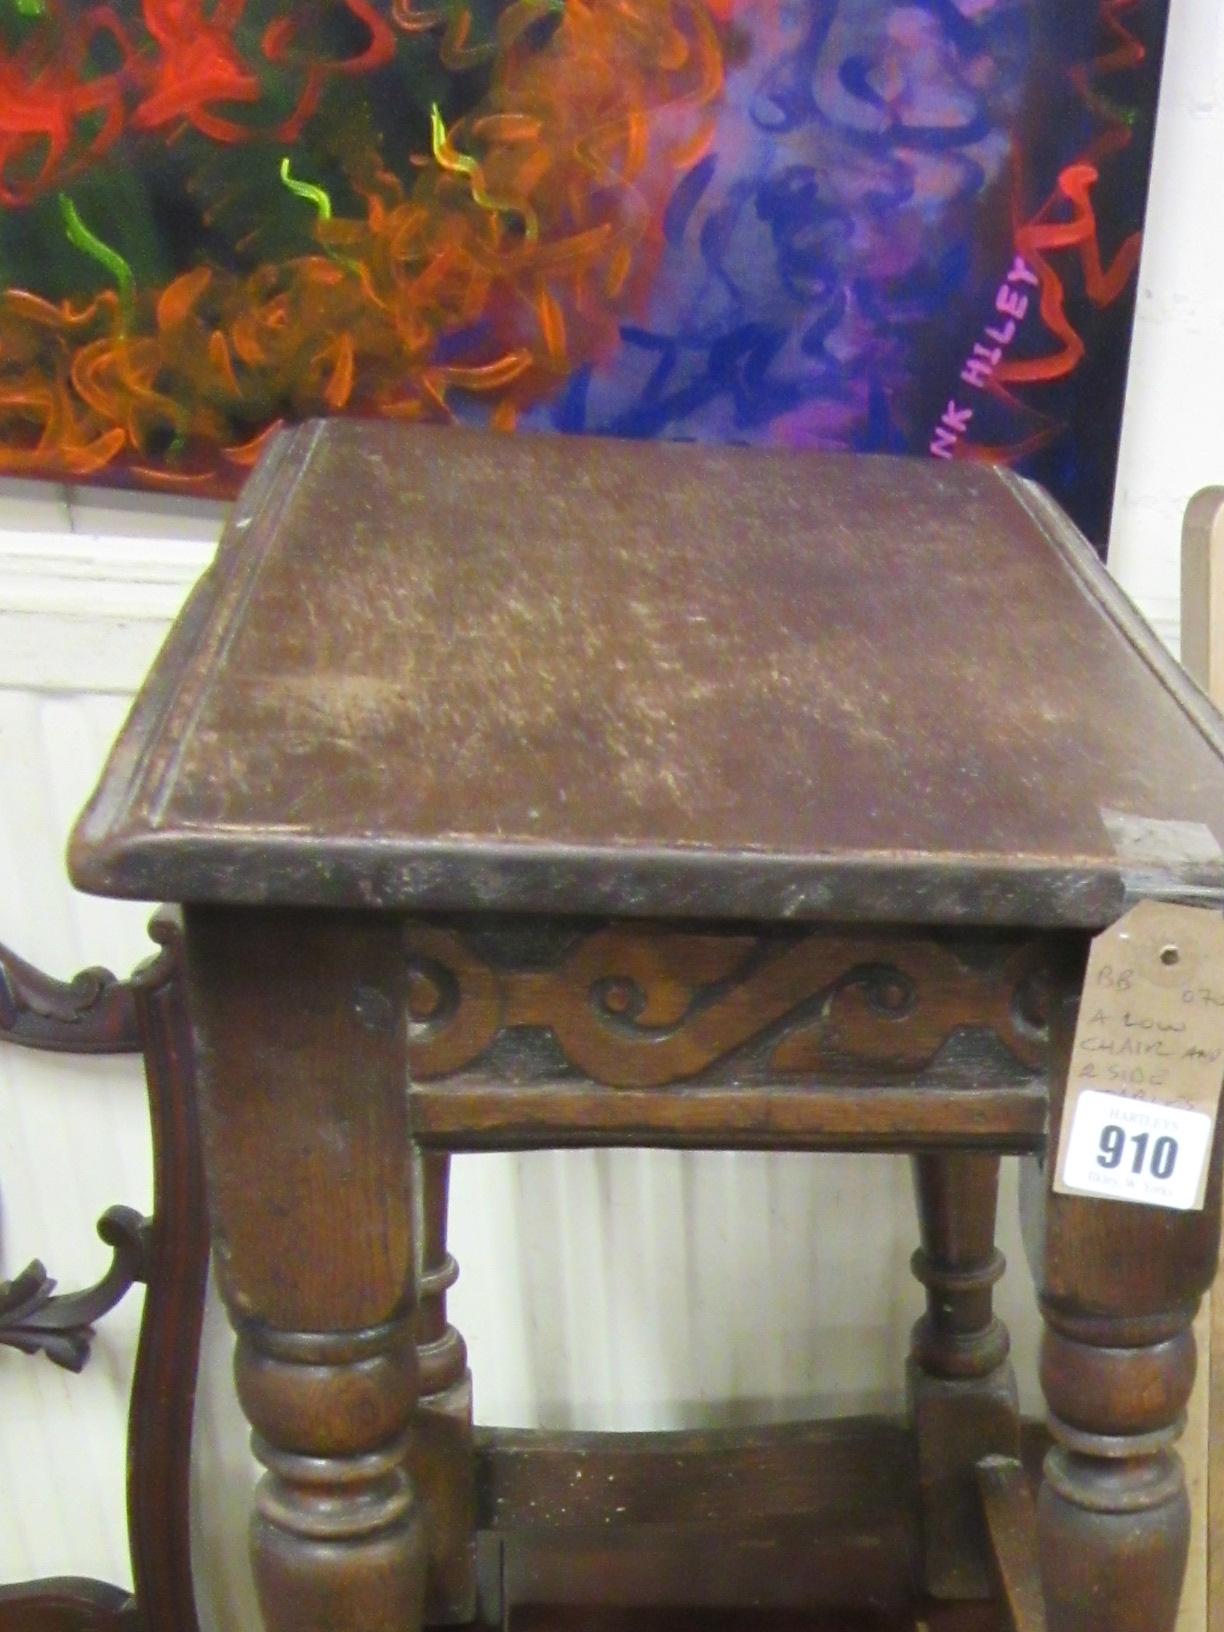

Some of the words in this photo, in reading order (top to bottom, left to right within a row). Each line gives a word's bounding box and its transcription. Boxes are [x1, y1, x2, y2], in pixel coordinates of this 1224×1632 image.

[960, 256, 1039, 388] HILEY
[1124, 1012, 1186, 1031] LOW
[1080, 1037, 1171, 1056] CHAIR
[1108, 1065, 1169, 1085] SIDE
[1096, 1124, 1179, 1180] 910
